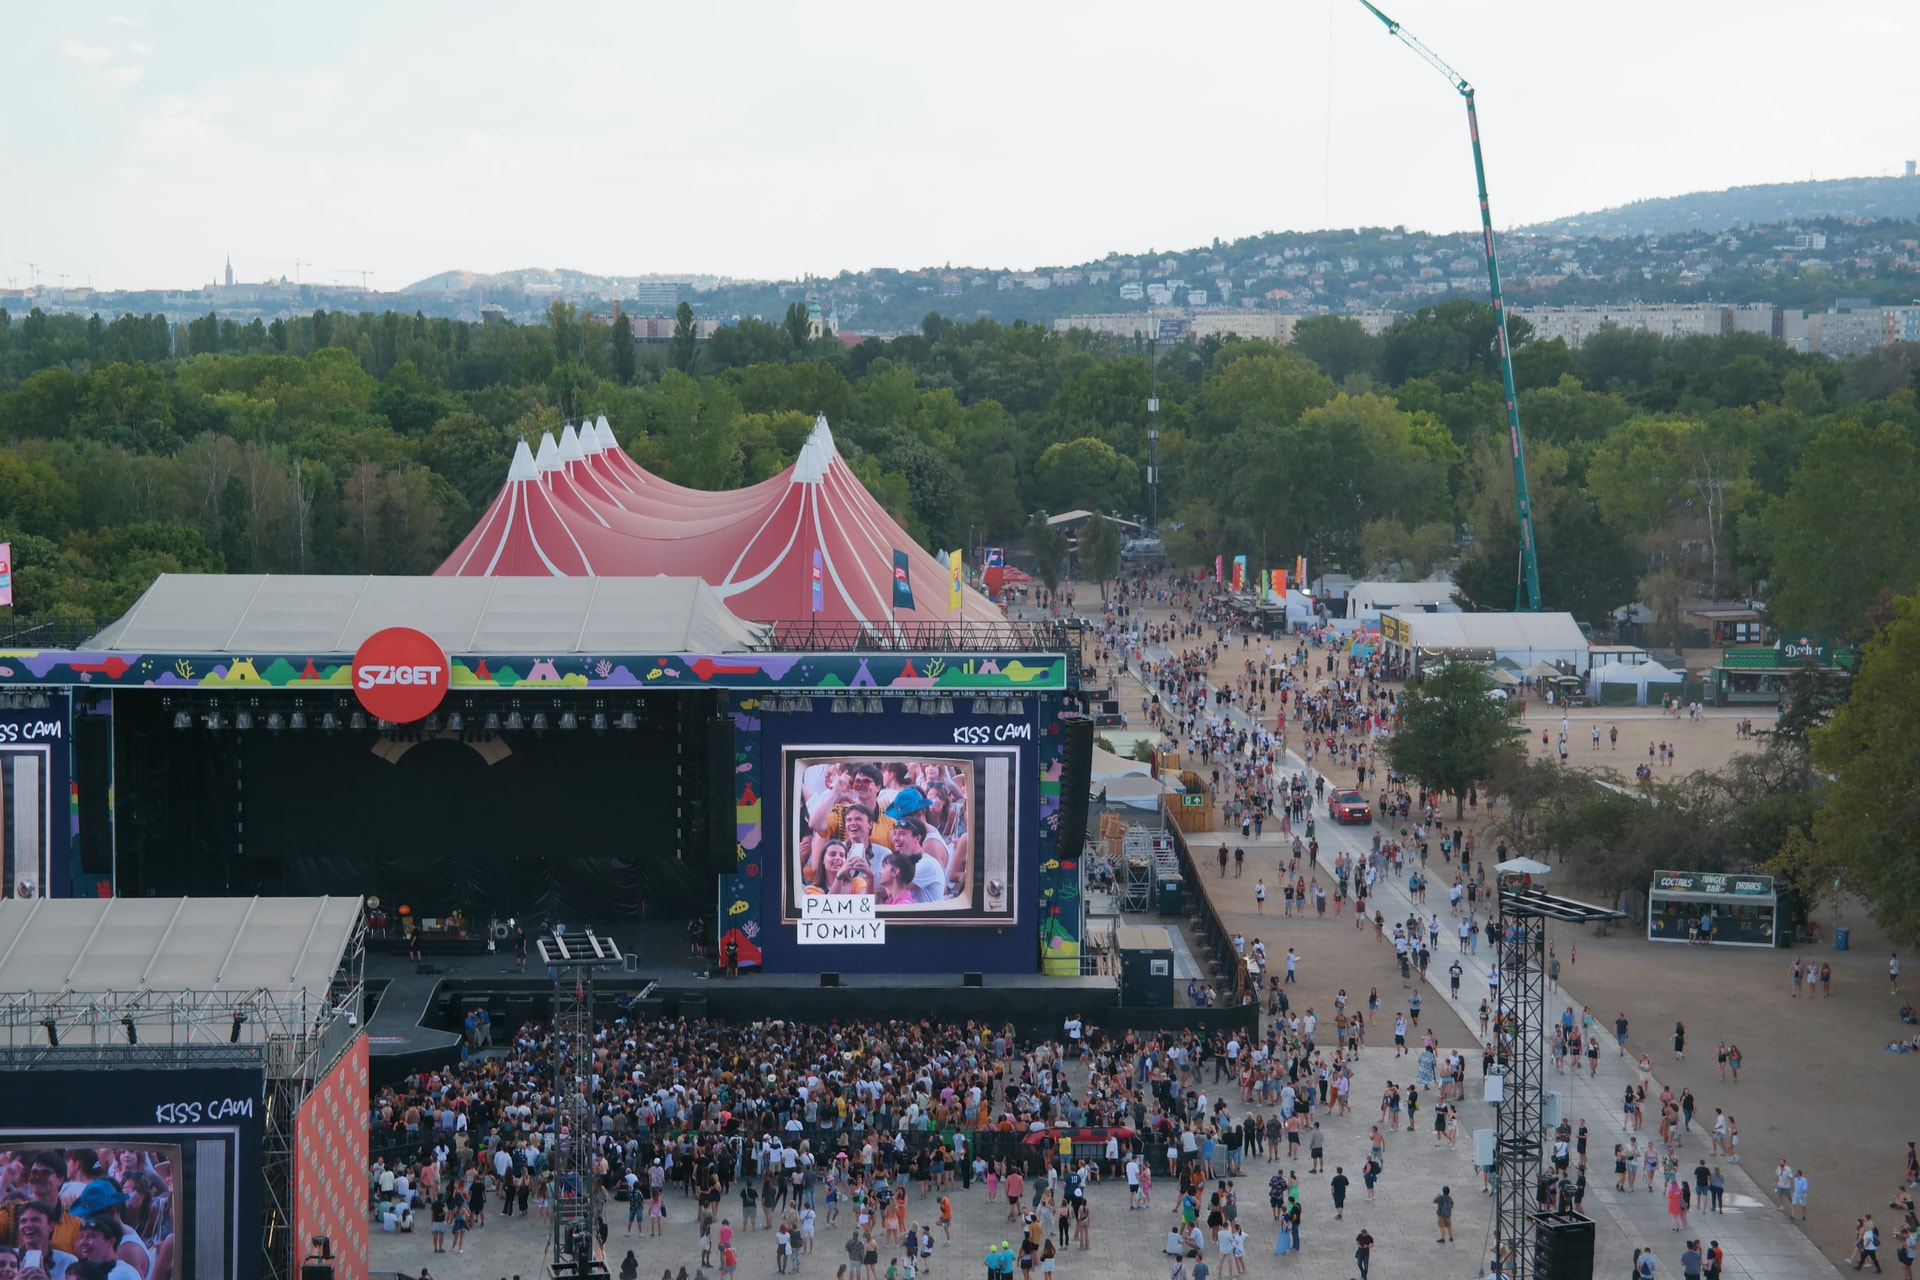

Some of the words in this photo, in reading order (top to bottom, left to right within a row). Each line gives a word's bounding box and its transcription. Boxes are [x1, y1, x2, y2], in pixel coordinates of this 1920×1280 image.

[23, 720, 61, 739] CAM
[953, 725, 990, 744] KISS
[994, 722, 1031, 741] CAM
[1701, 875, 1727, 884] JUNGLE
[1735, 881, 1762, 891] DRINKS
[1706, 884, 1720, 893] BAR
[806, 898, 853, 914] PAM
[859, 897, 871, 913] &
[801, 922, 881, 939] TOMMY
[156, 1101, 202, 1124] KISS
[207, 1097, 253, 1120] CAM
